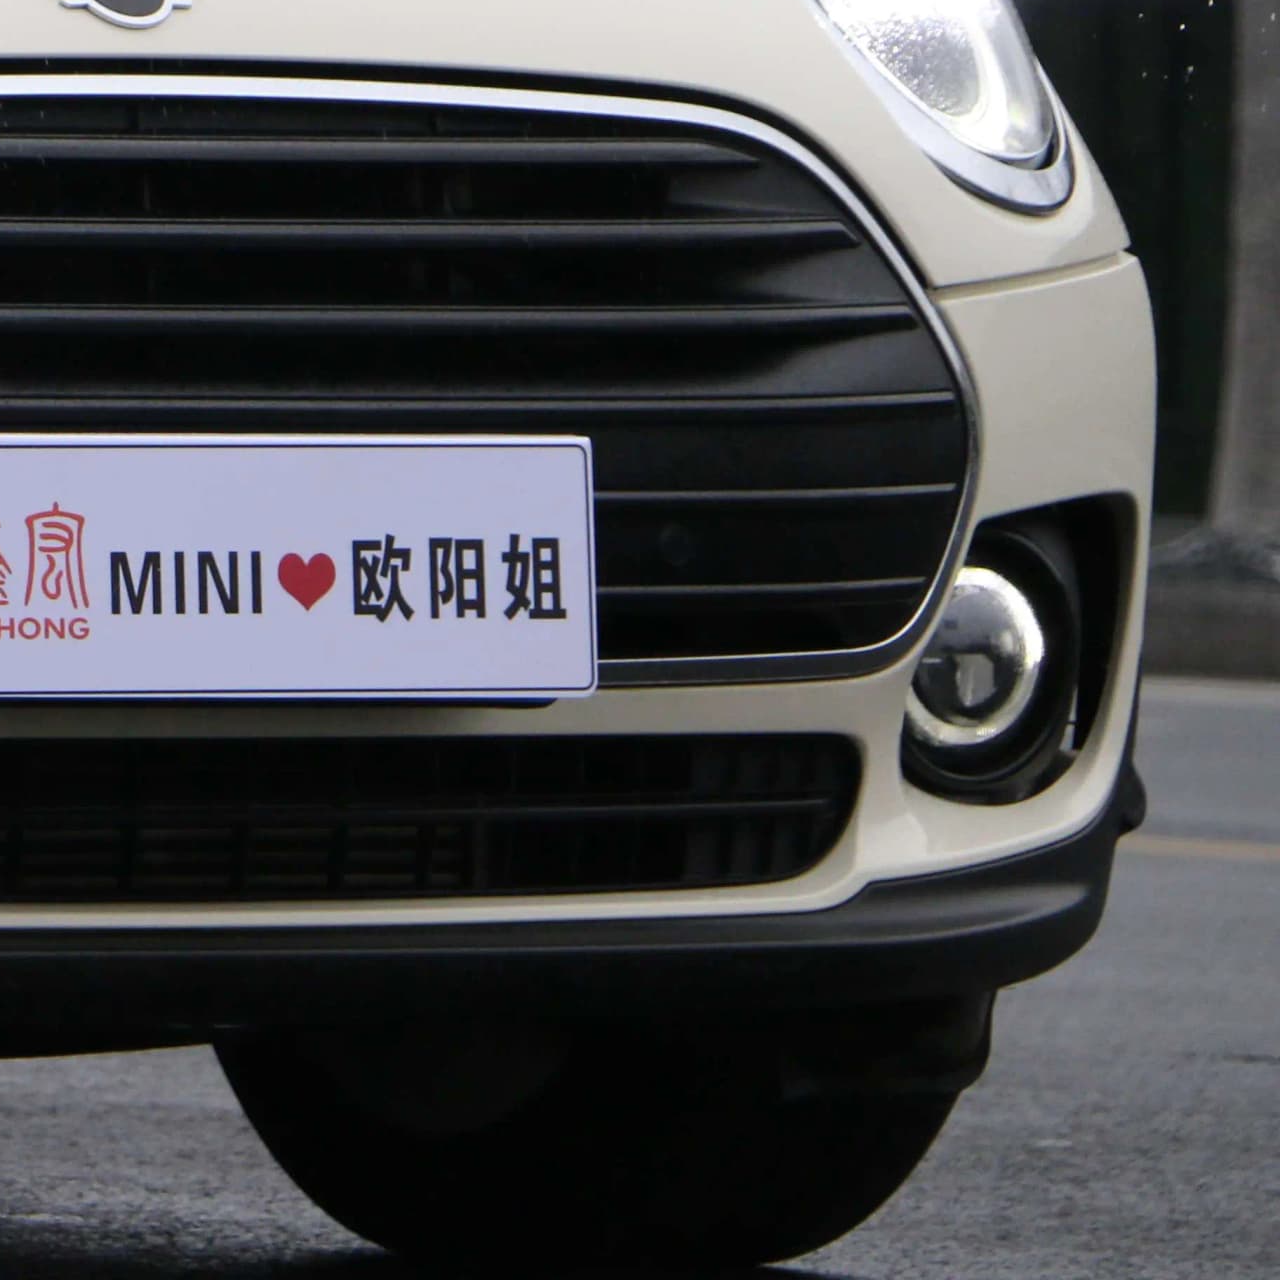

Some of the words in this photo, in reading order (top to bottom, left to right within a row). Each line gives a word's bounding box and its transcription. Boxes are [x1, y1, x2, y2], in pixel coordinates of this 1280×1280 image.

[110, 551, 263, 615] MINI
[352, 534, 568, 623] 欧阳姐
